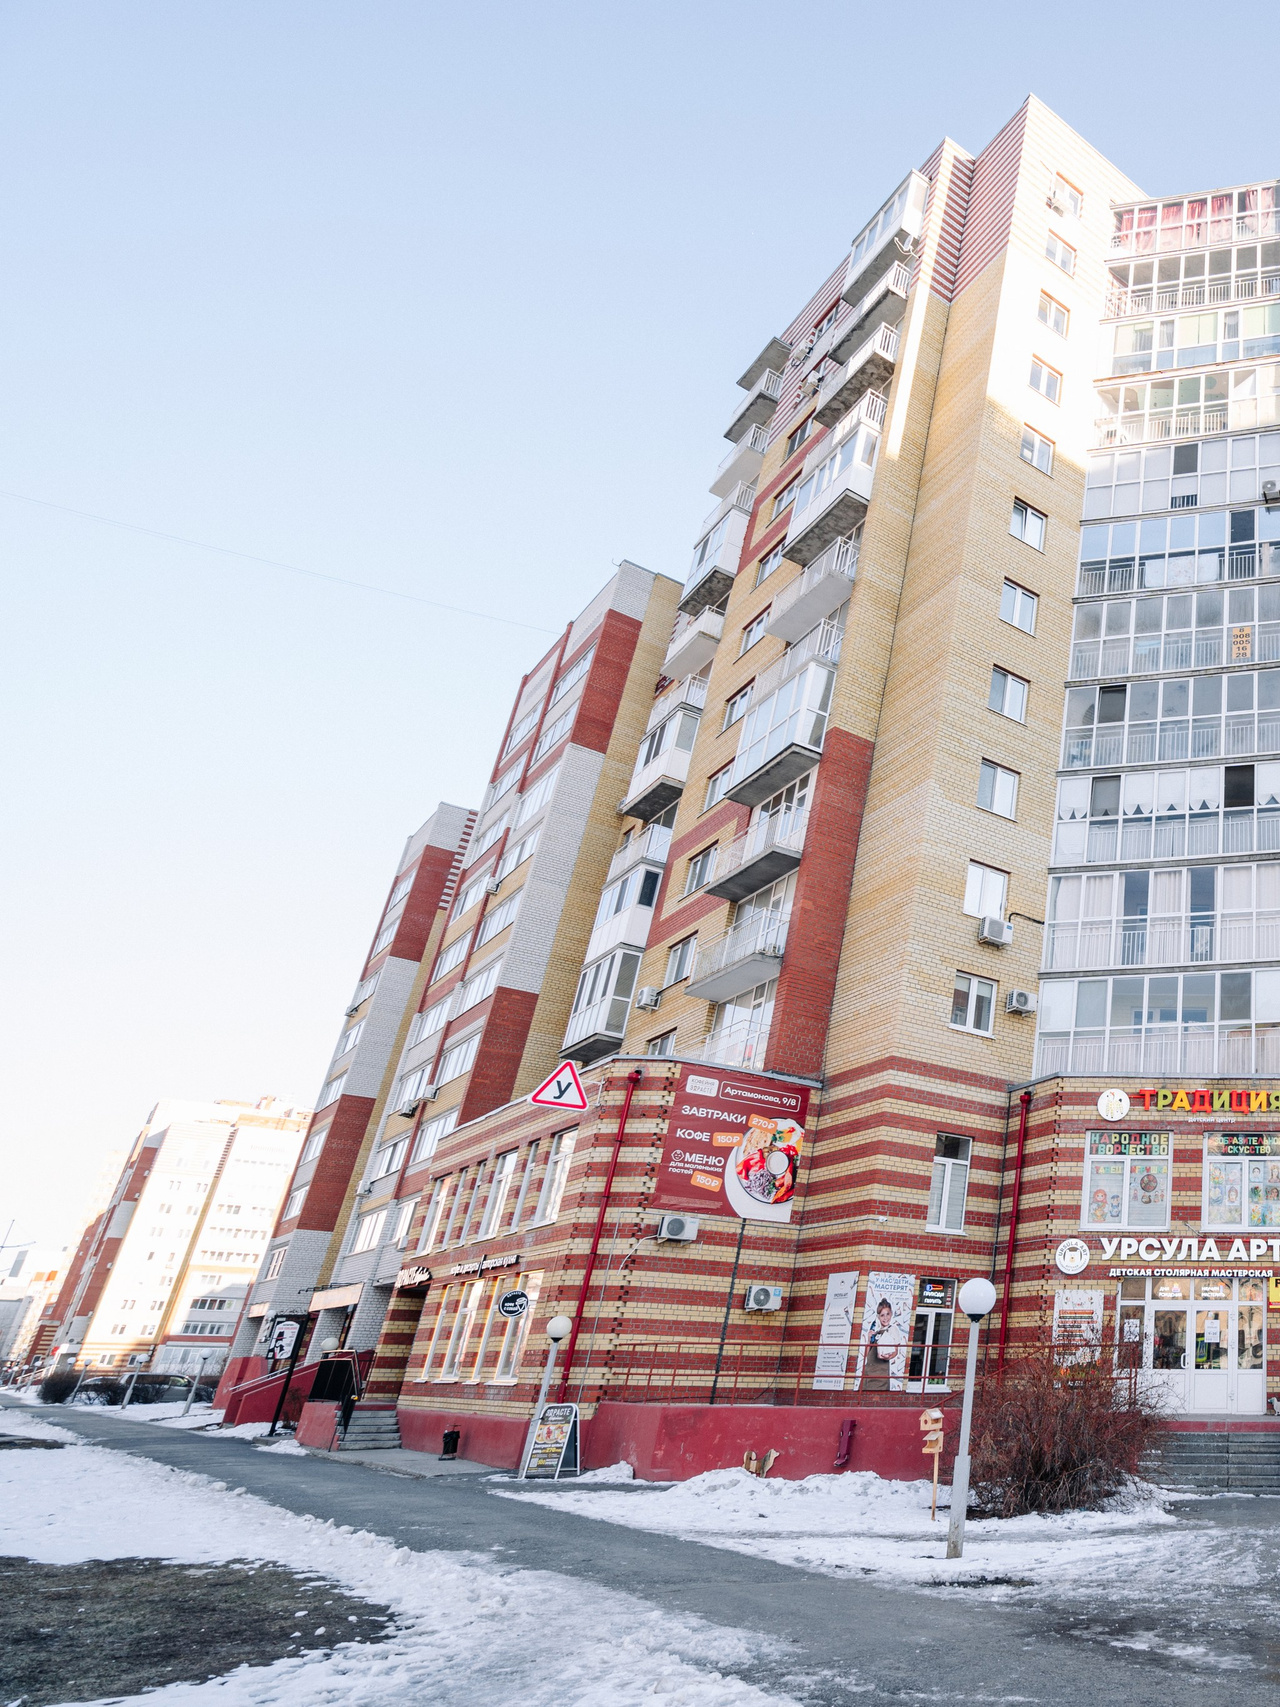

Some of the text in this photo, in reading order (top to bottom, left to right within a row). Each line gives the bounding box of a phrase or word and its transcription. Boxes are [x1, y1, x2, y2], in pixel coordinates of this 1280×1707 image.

[553, 1080, 572, 1099] У
[724, 1086, 796, 1106] Артамонова, 9/8
[682, 1105, 746, 1124] ЗАВТРАКИ
[676, 1128, 710, 1142] КОФЕ
[1091, 1133, 1168, 1144] НАРОДНОЕ
[1091, 1144, 1168, 1155] ТВОРЧЕСТВО
[684, 1152, 724, 1166] МЕНЮ
[685, 1163, 723, 1172] маленьких
[1100, 1237, 1227, 1261] УРСУЛА
[1109, 1268, 1273, 1277] ДЕТСКАЯ СТОЛЯРНАЯ МАСТЕРСКАЯ
